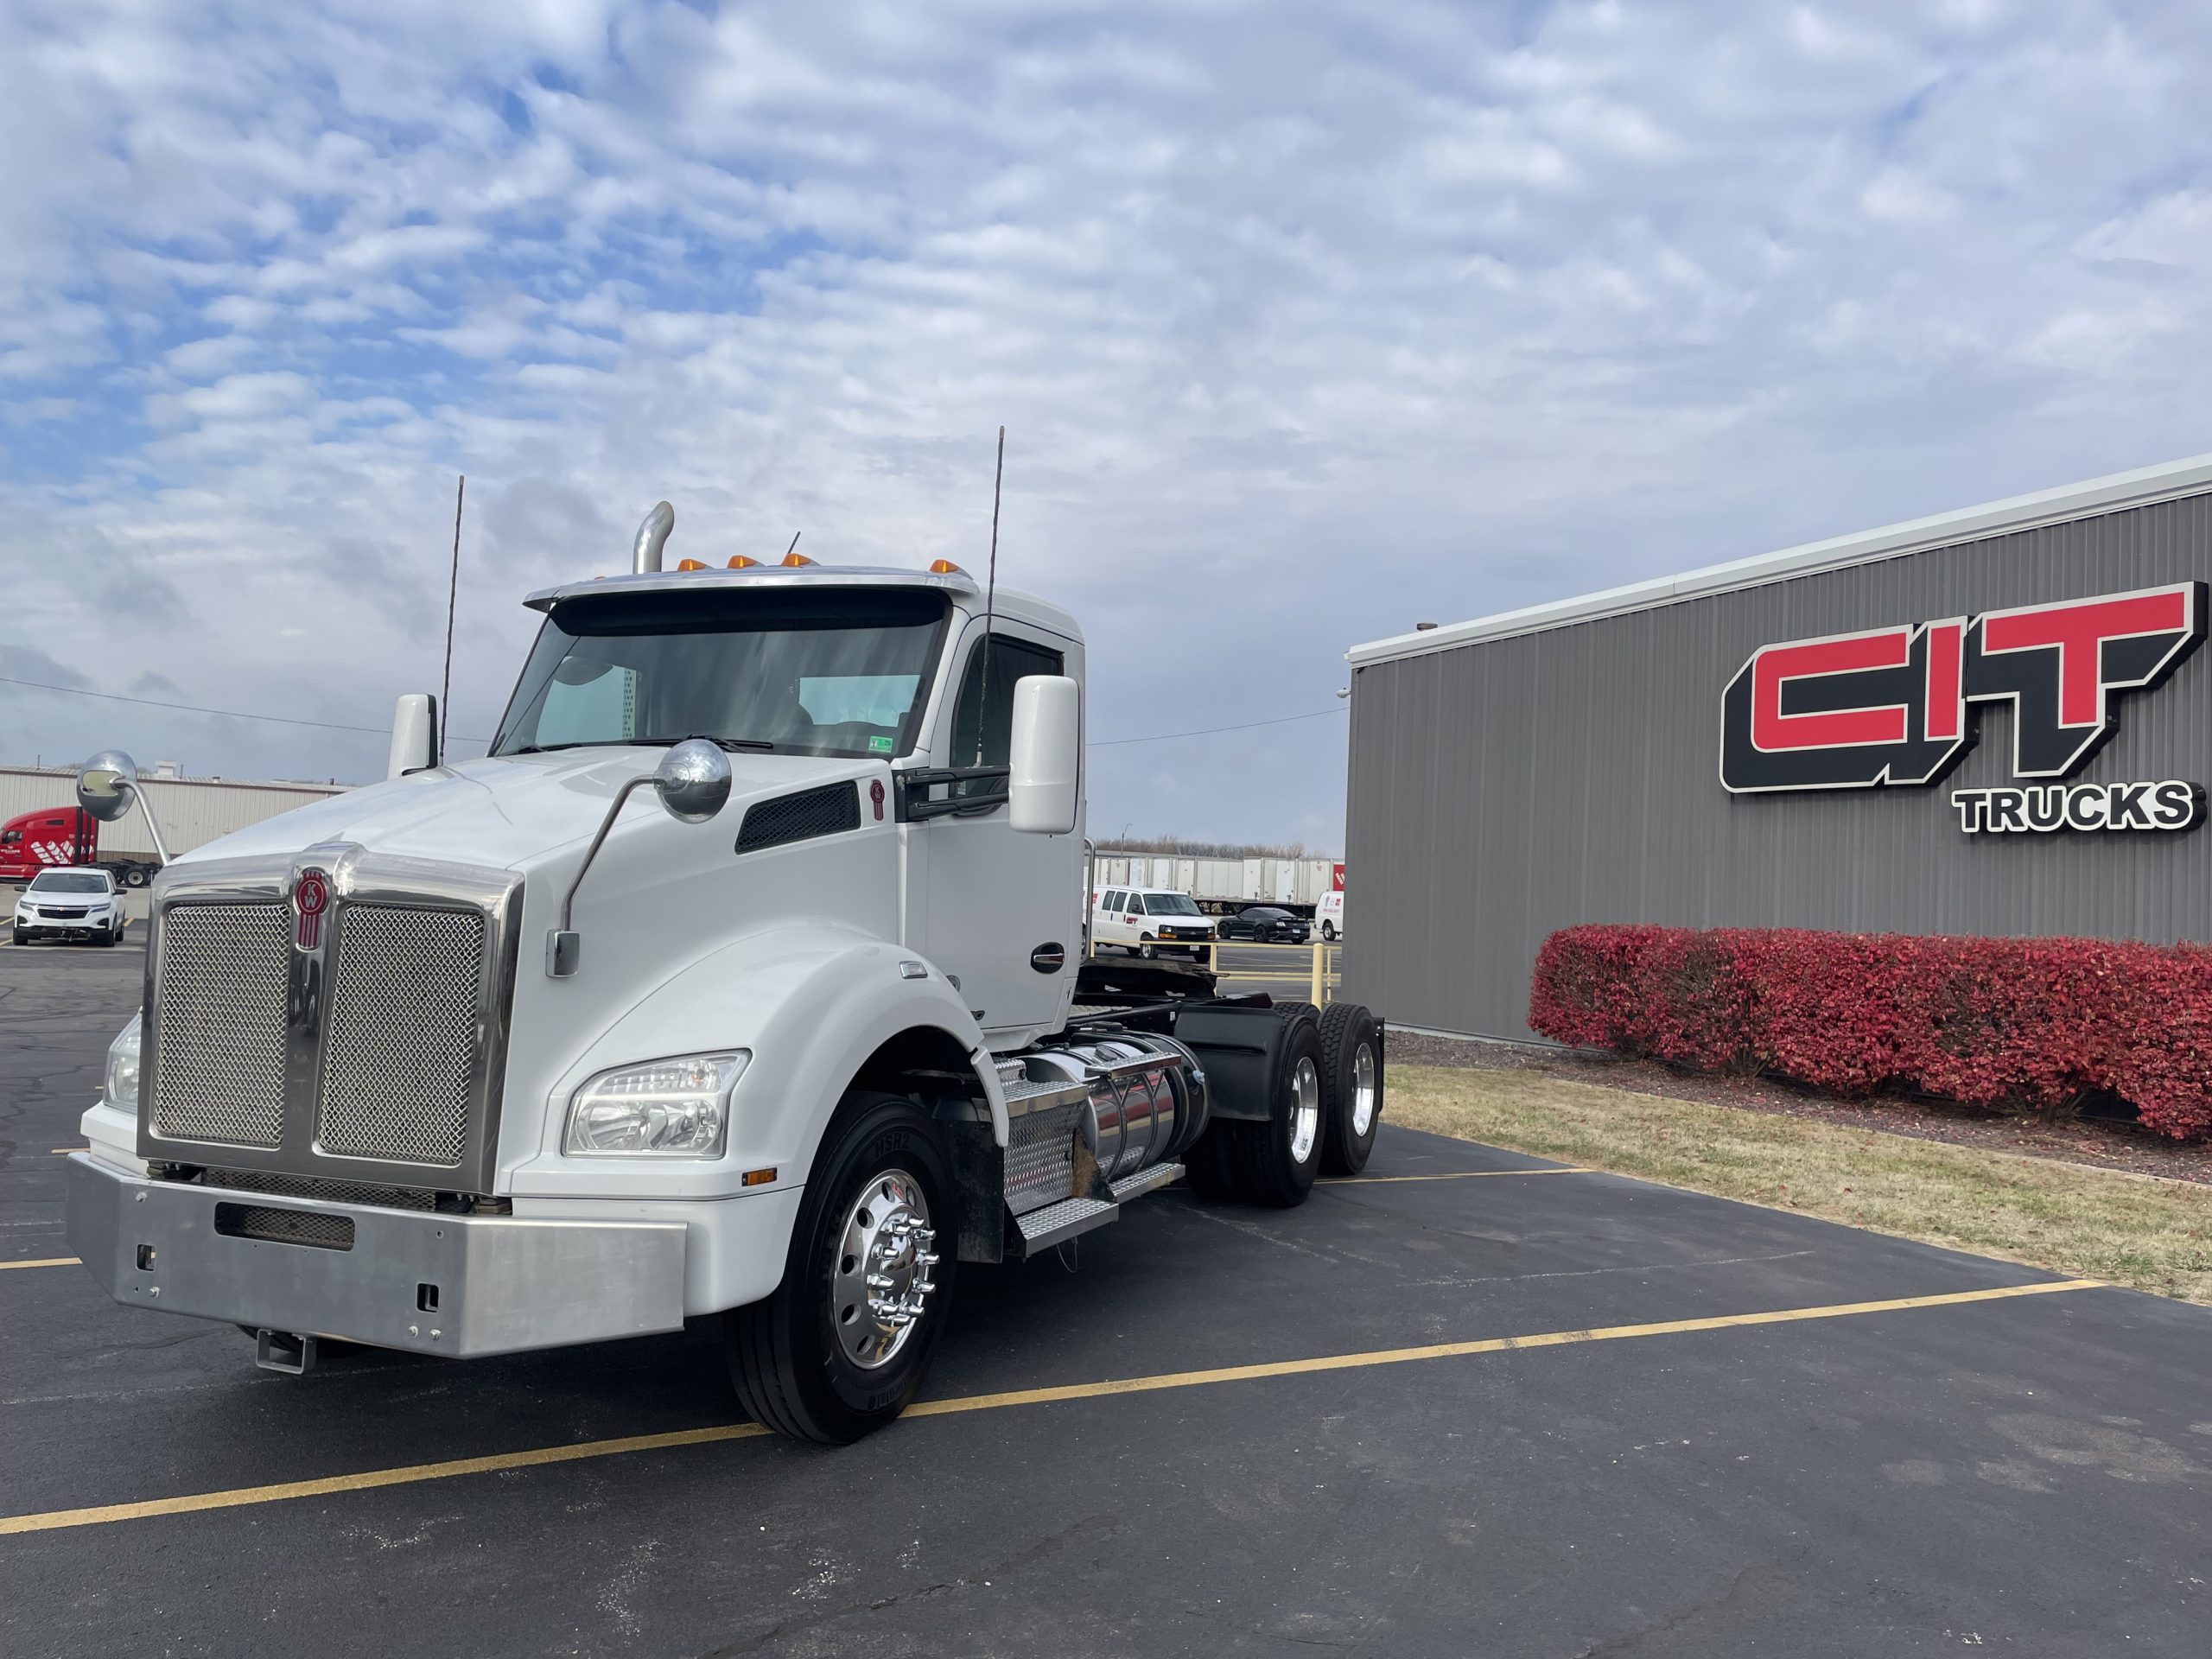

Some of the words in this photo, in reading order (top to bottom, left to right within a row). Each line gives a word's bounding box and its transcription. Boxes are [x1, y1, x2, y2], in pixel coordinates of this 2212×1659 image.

[1720, 582, 2202, 792] CIT
[1951, 781, 2196, 834] TRUCKS
[875, 1133, 910, 1158] HSR2
